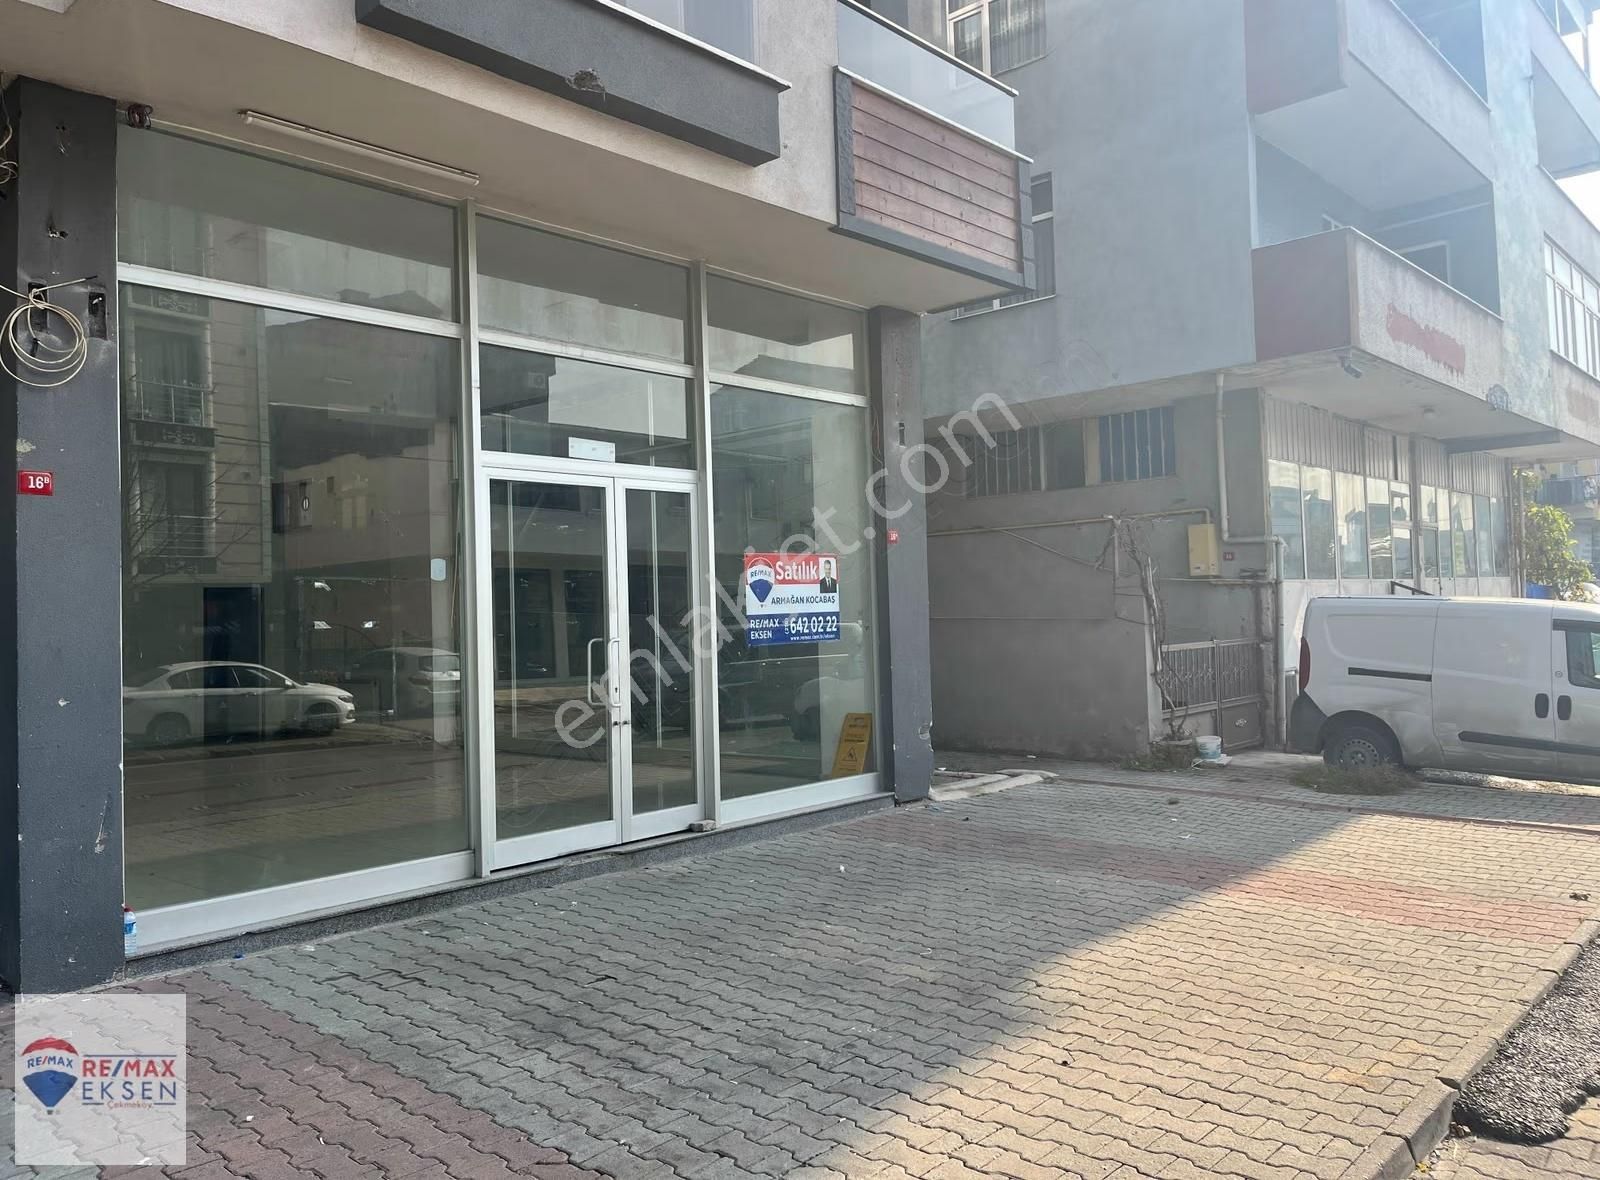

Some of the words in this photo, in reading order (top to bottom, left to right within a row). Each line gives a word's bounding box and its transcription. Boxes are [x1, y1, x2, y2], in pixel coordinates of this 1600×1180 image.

[750, 569, 772, 578] RE/MAX
[775, 560, 819, 580] Satılık
[771, 594, 805, 605] ARMAĞAN
[805, 595, 836, 604] KOCABAŞ
[750, 618, 780, 629] RE/MAX
[790, 616, 809, 634] 642
[810, 616, 824, 632] 02
[826, 615, 838, 632] 22
[750, 630, 773, 640] EKSEN
